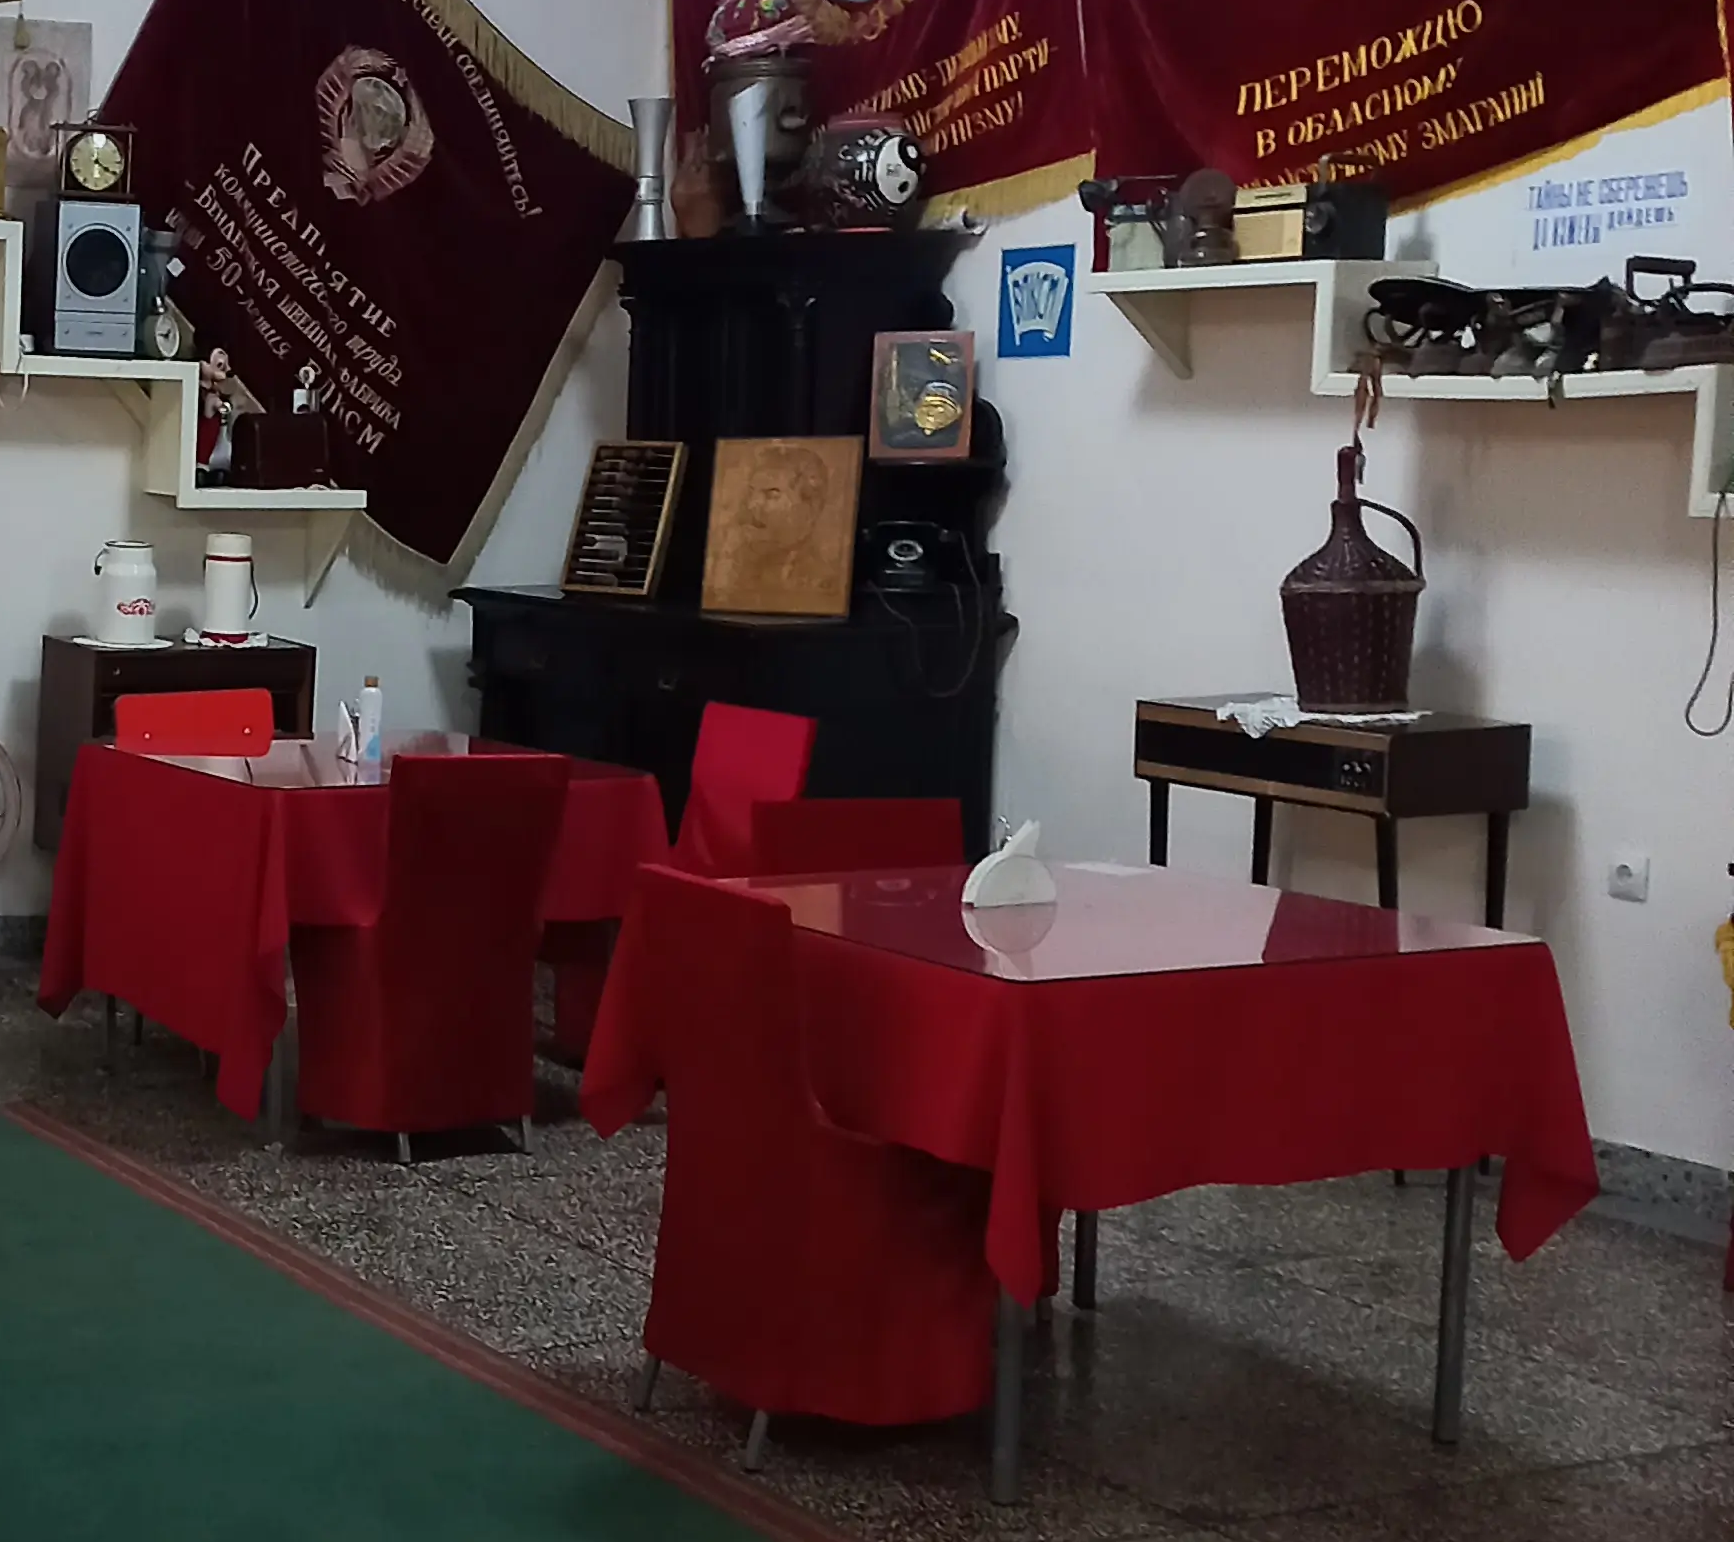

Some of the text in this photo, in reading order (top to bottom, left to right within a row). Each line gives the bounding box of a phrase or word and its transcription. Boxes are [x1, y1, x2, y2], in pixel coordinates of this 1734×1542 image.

[1236, 0, 1483, 116] ПЕРЕМОЖЦЮ
[1255, 56, 1464, 159] В ОБЛАСНОМУ
[1418, 70, 1546, 150] ЗМАГАННІ
